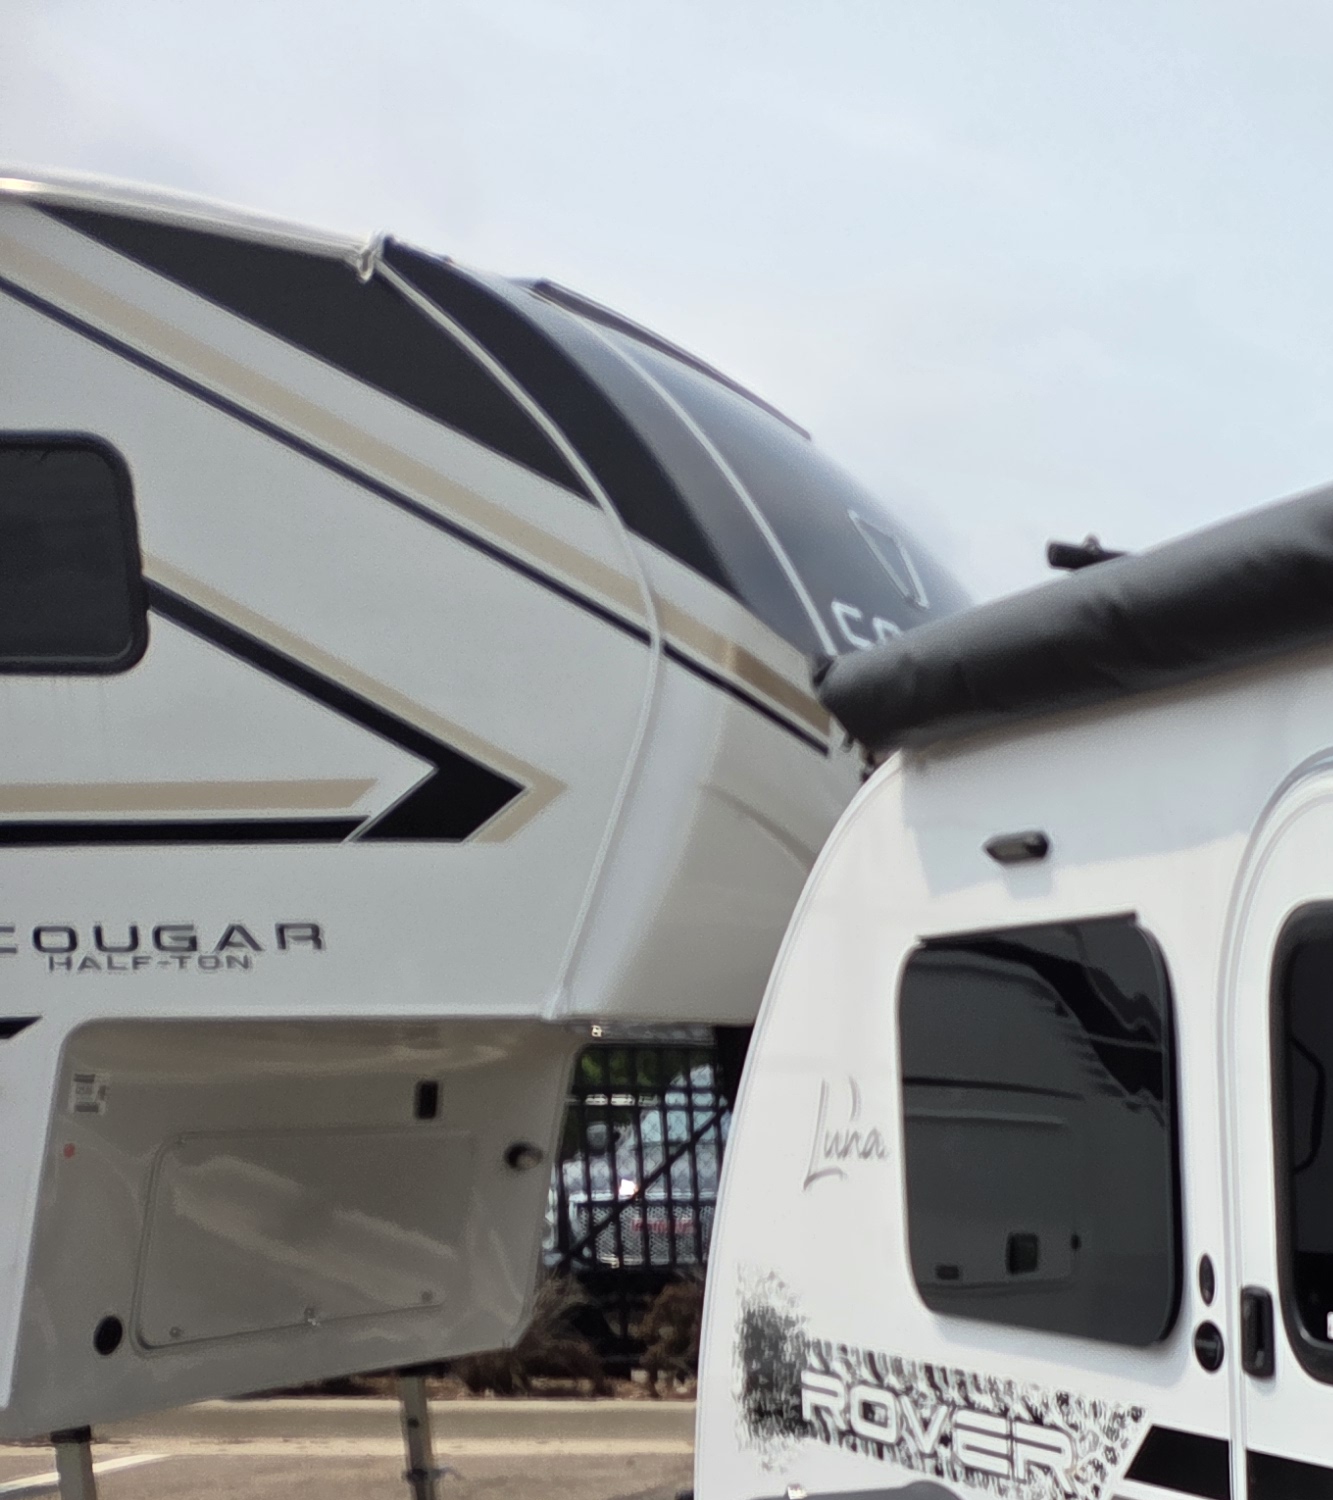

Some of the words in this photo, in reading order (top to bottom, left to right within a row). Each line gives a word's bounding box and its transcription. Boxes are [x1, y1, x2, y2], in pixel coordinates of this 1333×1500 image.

[49, 954, 251, 972] HALF-TON
[803, 1076, 888, 1190] Luna
[800, 1369, 1075, 1496] ROVER
